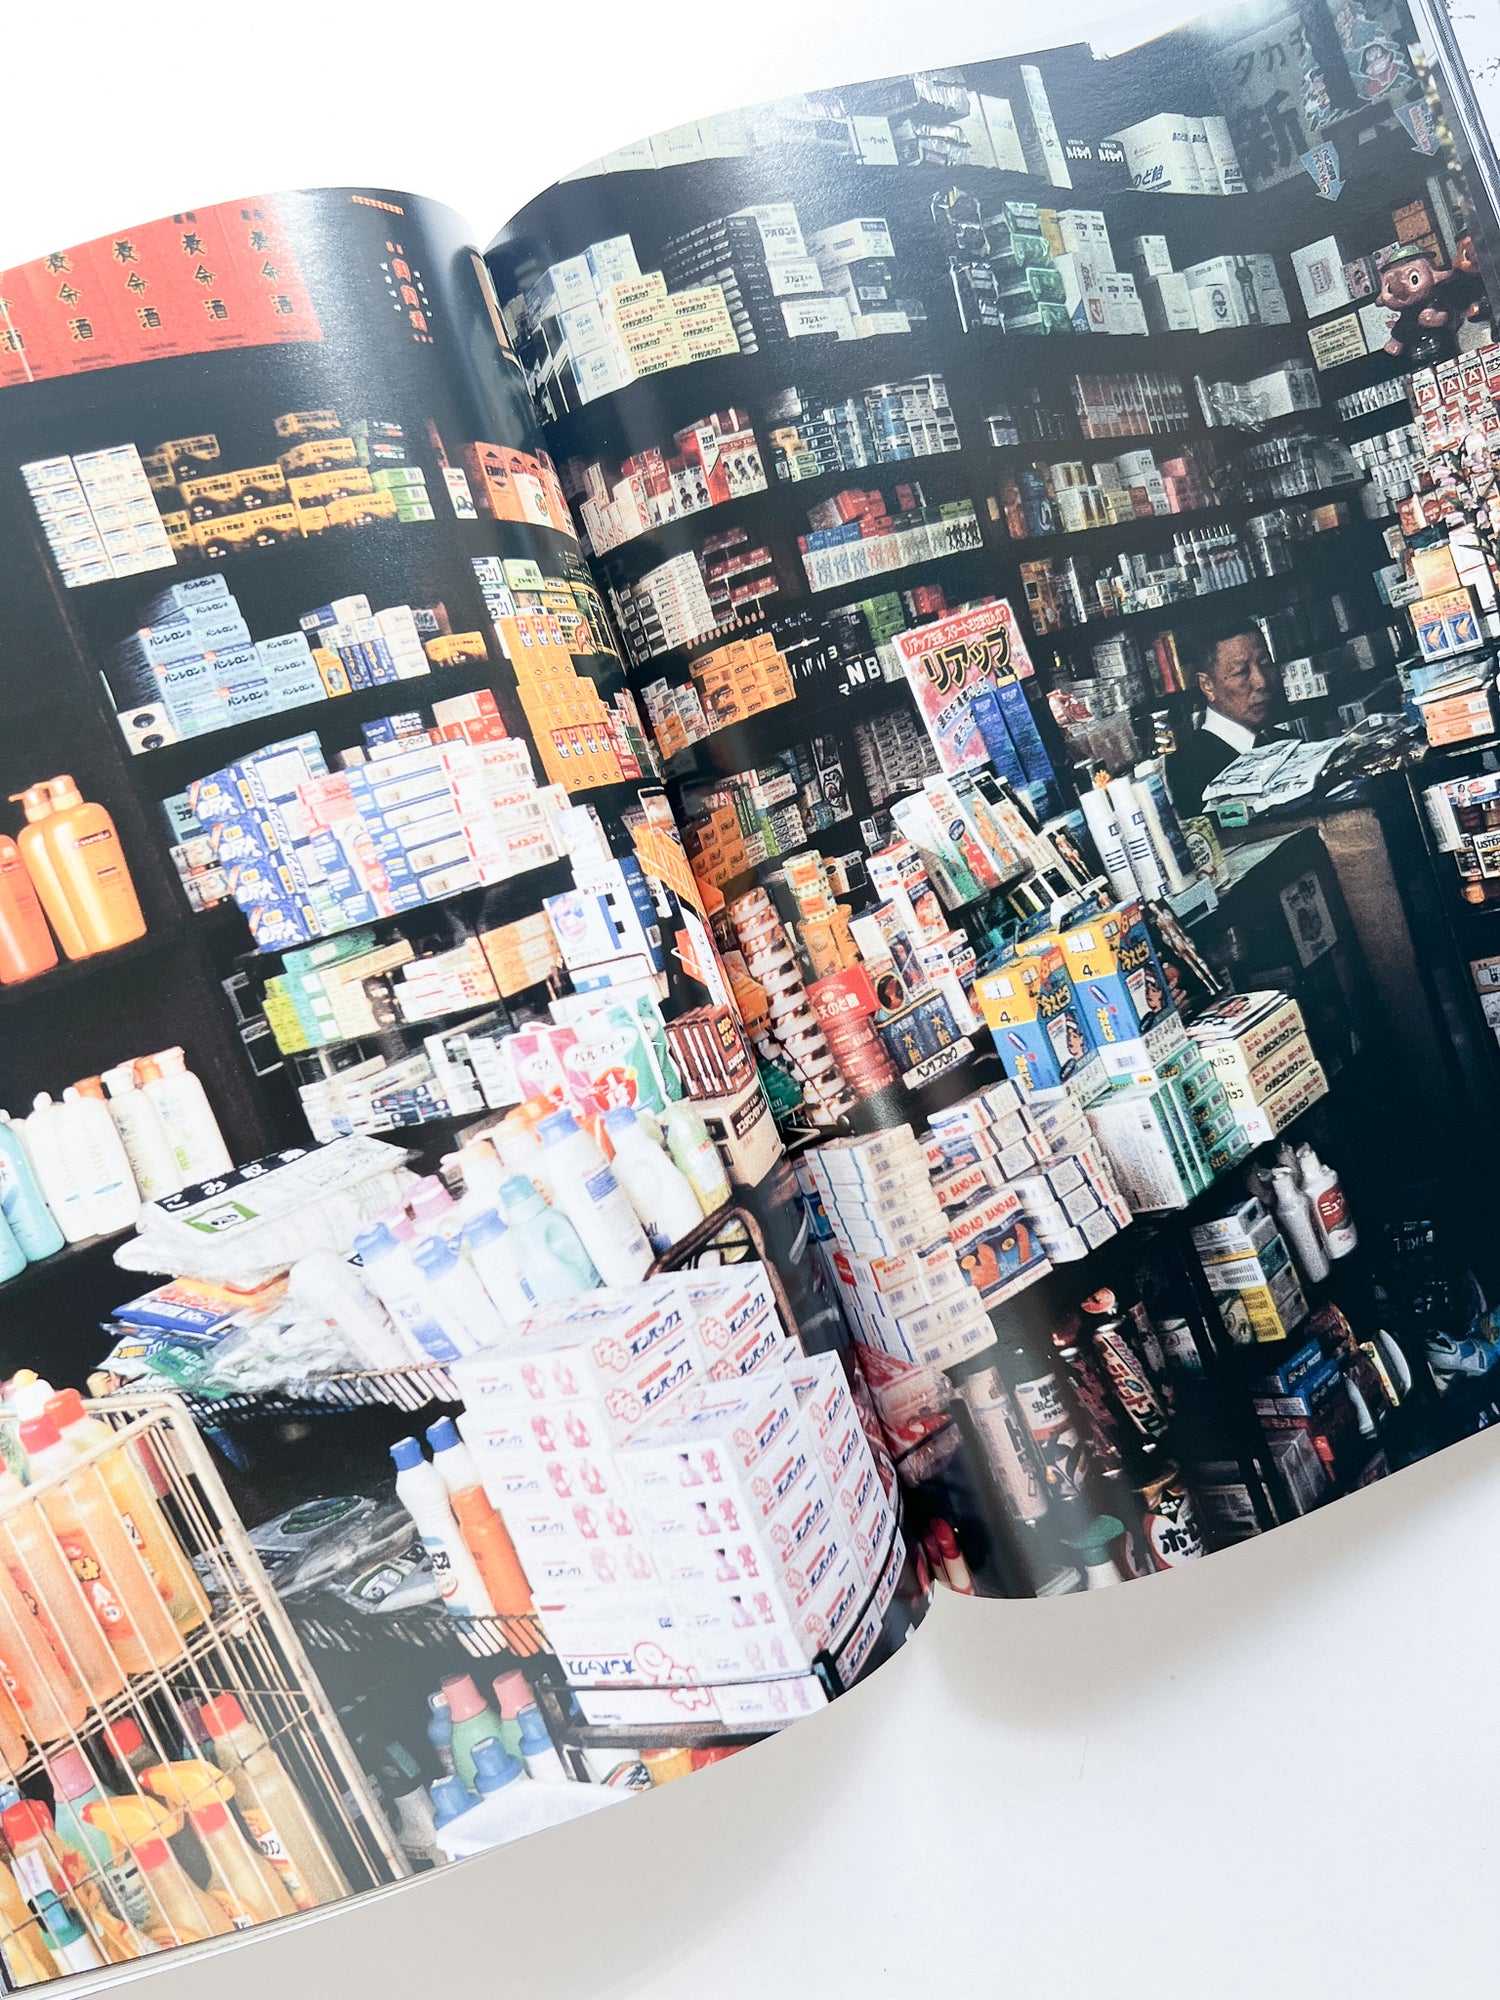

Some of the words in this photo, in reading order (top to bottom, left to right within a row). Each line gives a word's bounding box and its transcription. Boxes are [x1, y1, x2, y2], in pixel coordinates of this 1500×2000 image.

[113, 239, 162, 329] 養命酒
[181, 231, 230, 320] 養命酒
[250, 230, 295, 315] 養命酒
[921, 623, 1011, 695] リアップ
[986, 1191, 1017, 1222] BAND-AID
[629, 1310, 682, 1356] オンパックス
[729, 1292, 766, 1335] オンパックス
[740, 1331, 776, 1376] オンパックス
[641, 1359, 693, 1407] オンパックス
[776, 1454, 806, 1497] オンパックス
[810, 1542, 838, 1586] オンパックス
